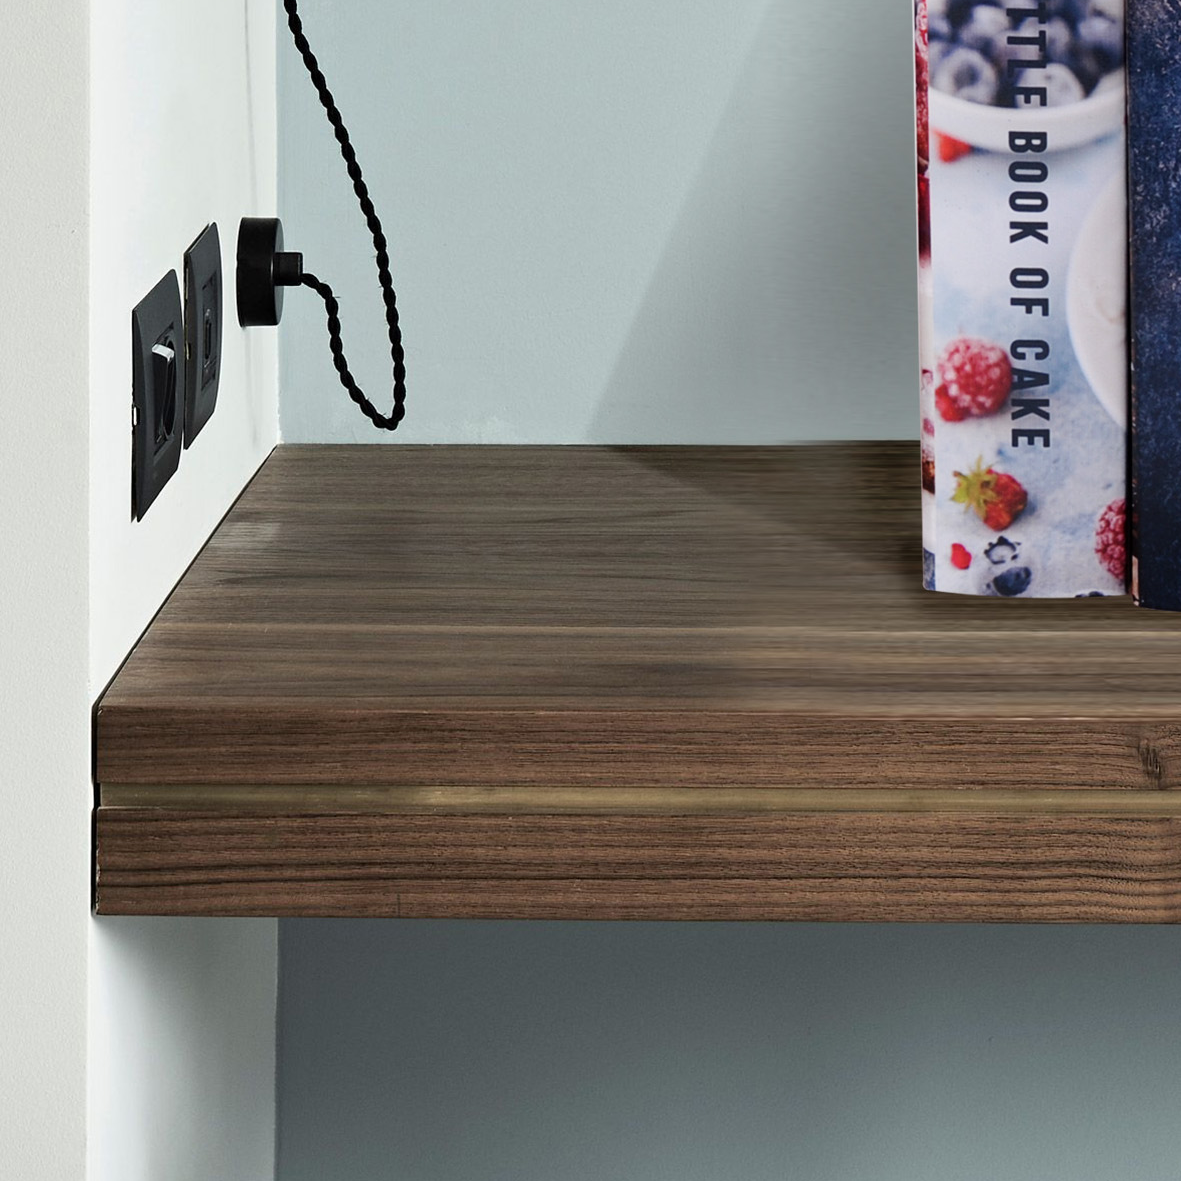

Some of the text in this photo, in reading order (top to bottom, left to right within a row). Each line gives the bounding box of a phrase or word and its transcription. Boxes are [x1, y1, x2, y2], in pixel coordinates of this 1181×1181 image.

[1008, 130, 1049, 244] BOOK
[1009, 267, 1050, 317] OF
[1009, 339, 1051, 448] CAKE
